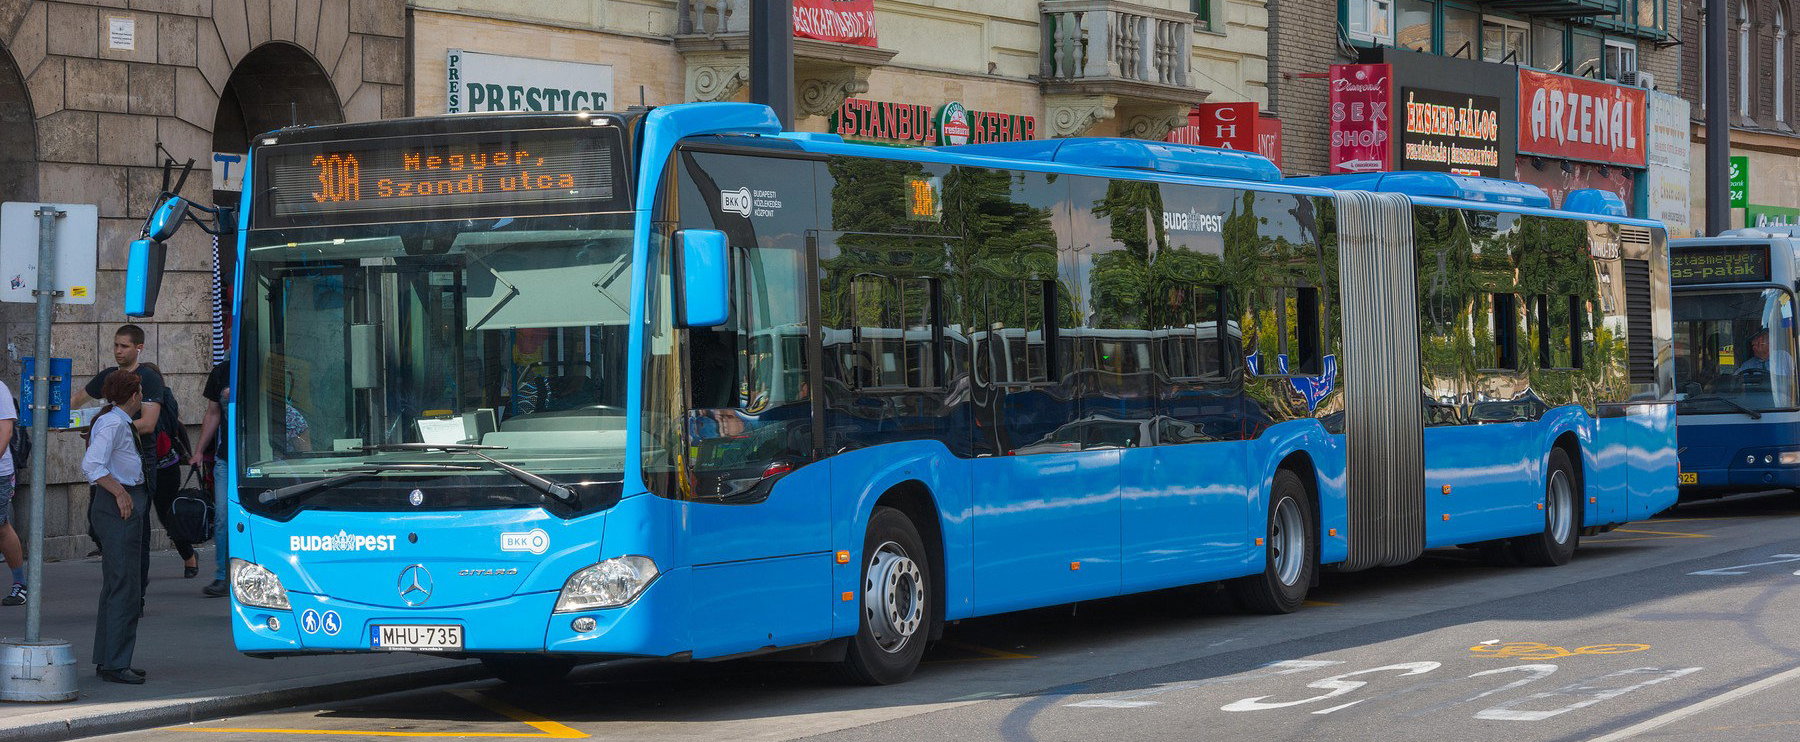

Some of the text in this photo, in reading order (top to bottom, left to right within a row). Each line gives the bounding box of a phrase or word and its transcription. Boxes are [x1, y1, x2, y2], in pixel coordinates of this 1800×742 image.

[1332, 77, 1387, 92] Diamond
[467, 83, 607, 112] PRESTIGE
[837, 98, 937, 143] ISTANBUL
[1332, 102, 1388, 122] SEX
[1406, 91, 1497, 141] ÉKSZER-ZÁLOG
[1531, 87, 1636, 153] ARZENÁL
[973, 110, 1036, 144] KEBAB
[1332, 130, 1388, 147] SHOP
[403, 151, 544, 172] Megyer,
[312, 154, 360, 203] 30A
[377, 170, 575, 199] Szondi utca
[725, 196, 739, 206] BKK
[753, 189, 777, 199] BUDAPESTI
[911, 179, 933, 216] 30A
[1731, 190, 1744, 200] 24
[754, 208, 774, 217] KÖZPONT
[507, 537, 528, 546] BKK
[458, 567, 518, 576] CITARO
[383, 627, 458, 645] MHU-735
